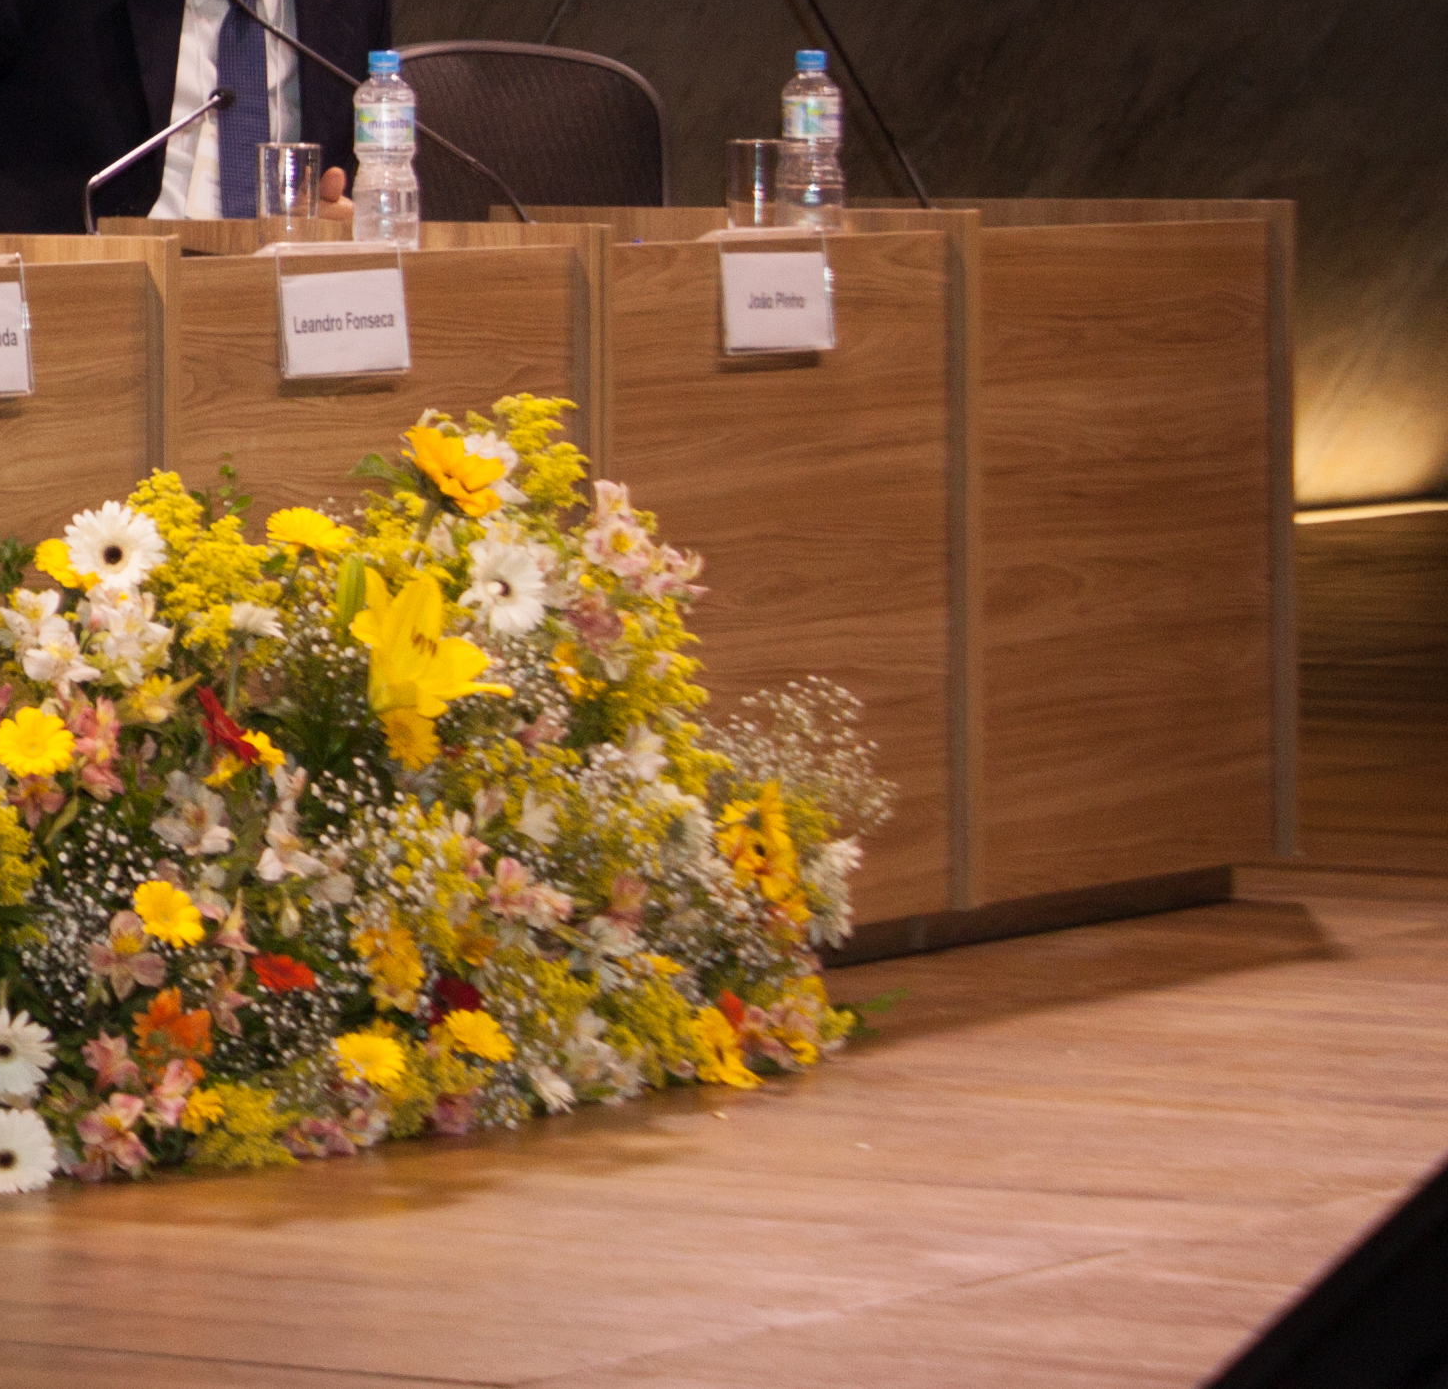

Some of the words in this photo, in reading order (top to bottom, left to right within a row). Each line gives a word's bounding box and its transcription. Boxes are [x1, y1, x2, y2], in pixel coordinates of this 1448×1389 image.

[748, 291, 773, 309] João
[293, 313, 343, 334] Leandro
[345, 312, 394, 330] Fonseca
